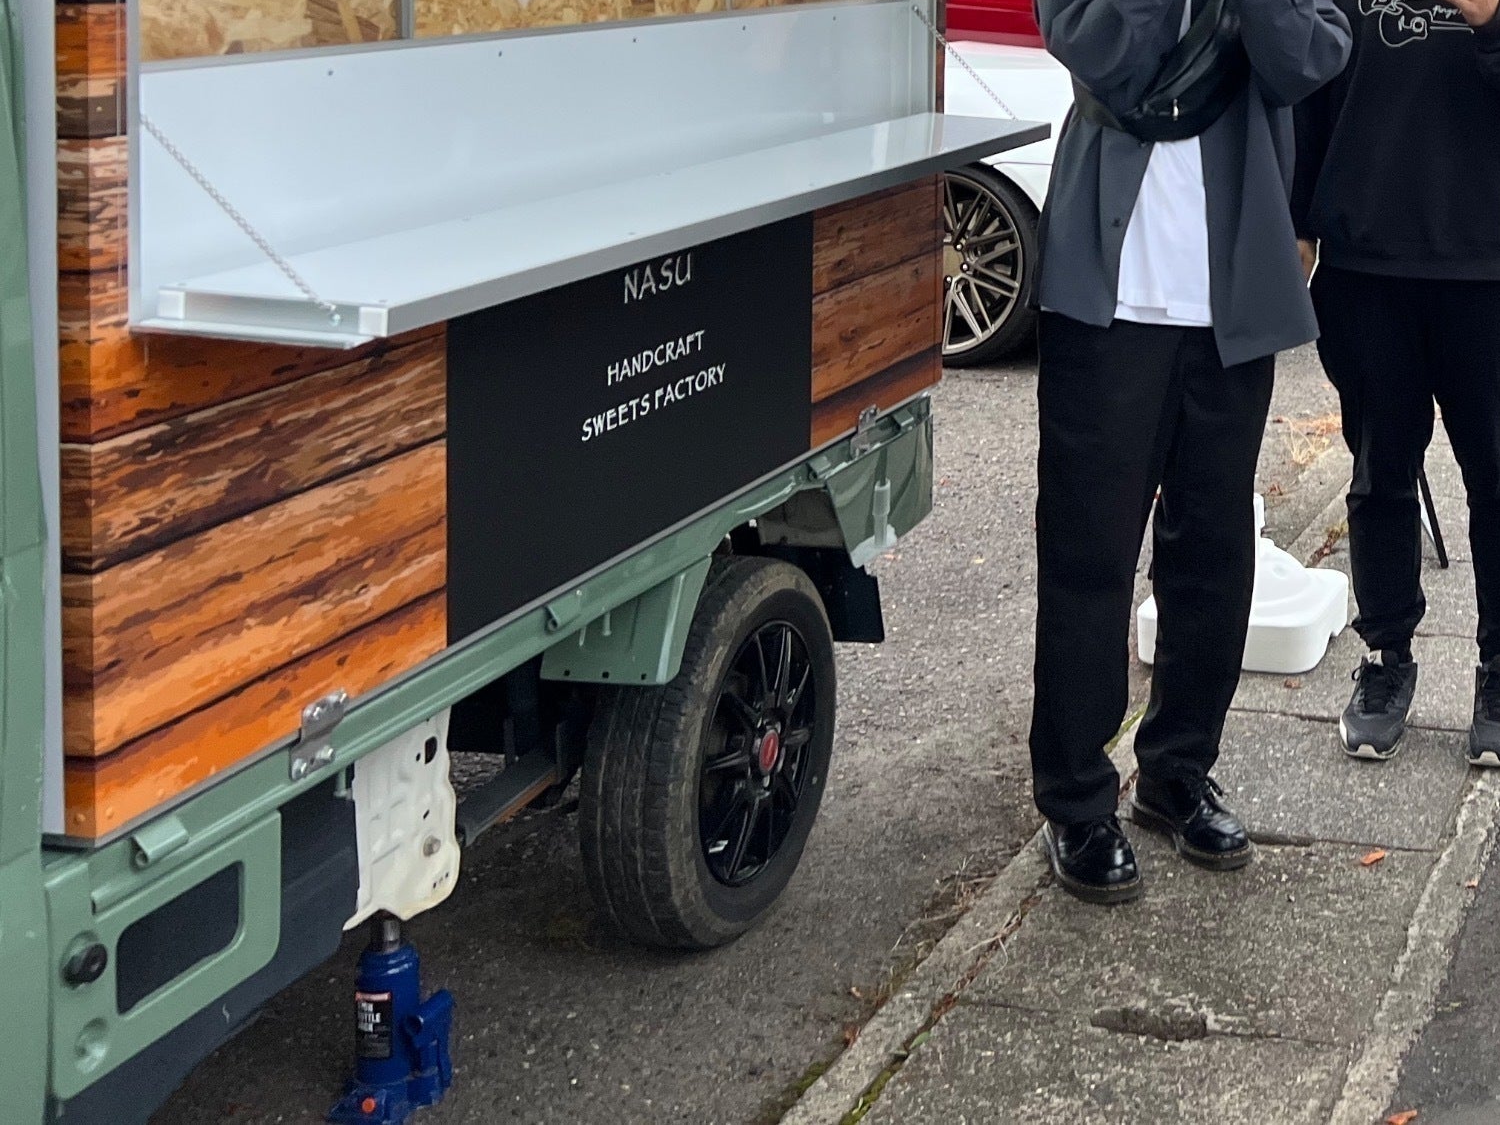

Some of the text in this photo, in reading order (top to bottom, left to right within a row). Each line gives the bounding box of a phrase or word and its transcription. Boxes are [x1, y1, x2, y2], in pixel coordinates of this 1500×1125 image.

[623, 252, 693, 304] NASU
[606, 329, 705, 386] HANDCRAFT
[581, 362, 726, 442] SWEETS FACTORY
